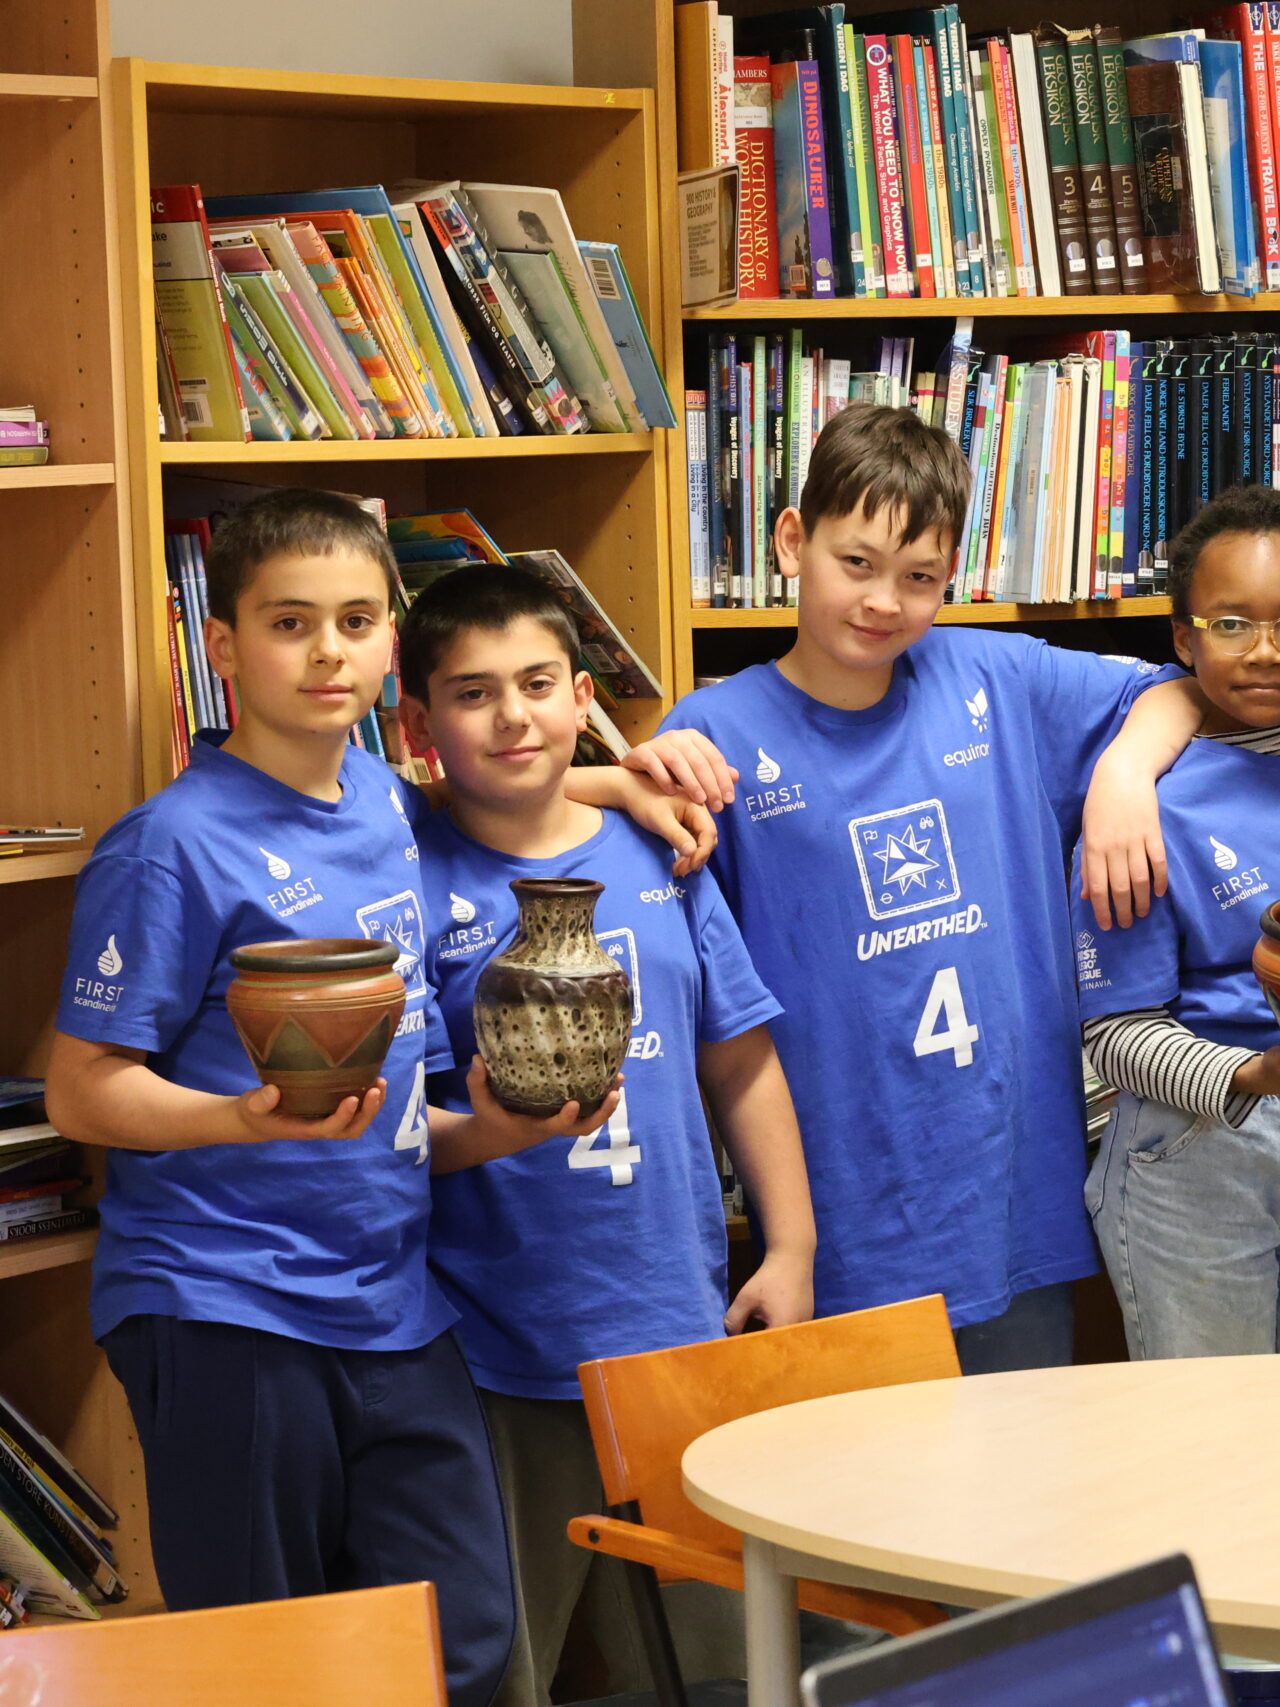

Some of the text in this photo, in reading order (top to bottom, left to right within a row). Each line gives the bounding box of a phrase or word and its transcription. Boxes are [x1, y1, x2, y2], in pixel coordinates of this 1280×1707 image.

[835, 22, 848, 92] VERDEN DAG
[937, 28, 952, 97] VERDEN DAG
[948, 22, 964, 91] VERDEN DAG
[1271, 41, 1280, 61] IKKE
[875, 67, 890, 105] WHAT
[1040, 55, 1062, 126] LEKSIKON
[1069, 53, 1091, 125] LEKSIKON
[1100, 54, 1121, 125] LEKSIKON
[880, 107, 894, 137] YOU
[1252, 42, 1276, 213] THE TRAVEL
[801, 79, 827, 209] DINOSAURER
[883, 140, 898, 176] NEED
[979, 119, 995, 195] OPPLEV PYRAMIDER
[734, 132, 751, 202] WORLD
[871, 94, 894, 251] The World and Graphics
[1013, 165, 1022, 188] 1970s
[694, 188, 713, 202] HISTORY
[887, 179, 901, 198] TO
[1063, 176, 1076, 195] 3
[1090, 175, 1106, 194] 4
[1122, 175, 1133, 194] 5
[687, 202, 713, 219] GEOGRAPHY
[750, 141, 767, 280] DICTIONARY OF
[890, 201, 906, 244] KNOW
[737, 208, 755, 290] HISTORY
[894, 245, 909, 276] NOW
[962, 282, 970, 290] 23
[974, 275, 979, 283] 8
[461, 274, 518, 368] NORSK FILM OG TEATER
[1159, 379, 1167, 407] NORGE
[1177, 383, 1185, 393] DE
[1243, 372, 1251, 423] KYSTLANDET
[1221, 377, 1229, 432] FERIELANDET
[729, 416, 737, 440] Voyages
[774, 416, 783, 440] Voyages
[964, 407, 973, 440] BRUKER
[1201, 432, 1208, 444] OG
[790, 422, 799, 464] EXPLORERS
[688, 463, 696, 483] Living
[699, 464, 708, 483] Living
[729, 449, 738, 478] Discovery
[774, 449, 783, 478] Discovery
[1143, 437, 1152, 508] OG FJORDBYGDER
[981, 422, 999, 538] Destination DETECTIVES JAPAN
[700, 506, 708, 532] Country
[943, 742, 990, 768] equinor
[745, 783, 804, 812] FIRST
[750, 798, 806, 822] scandinavia
[267, 877, 314, 910] FIRST
[1212, 866, 1265, 900] FIRST
[1220, 882, 1270, 911] scandinavia
[278, 892, 324, 919] scandinavia
[438, 920, 495, 949] FIRST
[439, 936, 496, 960] scandinavia
[856, 904, 983, 962] UNEARTHED
[76, 978, 124, 1002] FIRST
[912, 966, 980, 1069] 4
[394, 1061, 429, 1166] 4
[567, 1086, 642, 1186] 4
[10, 1224, 36, 1237] BOOKS
